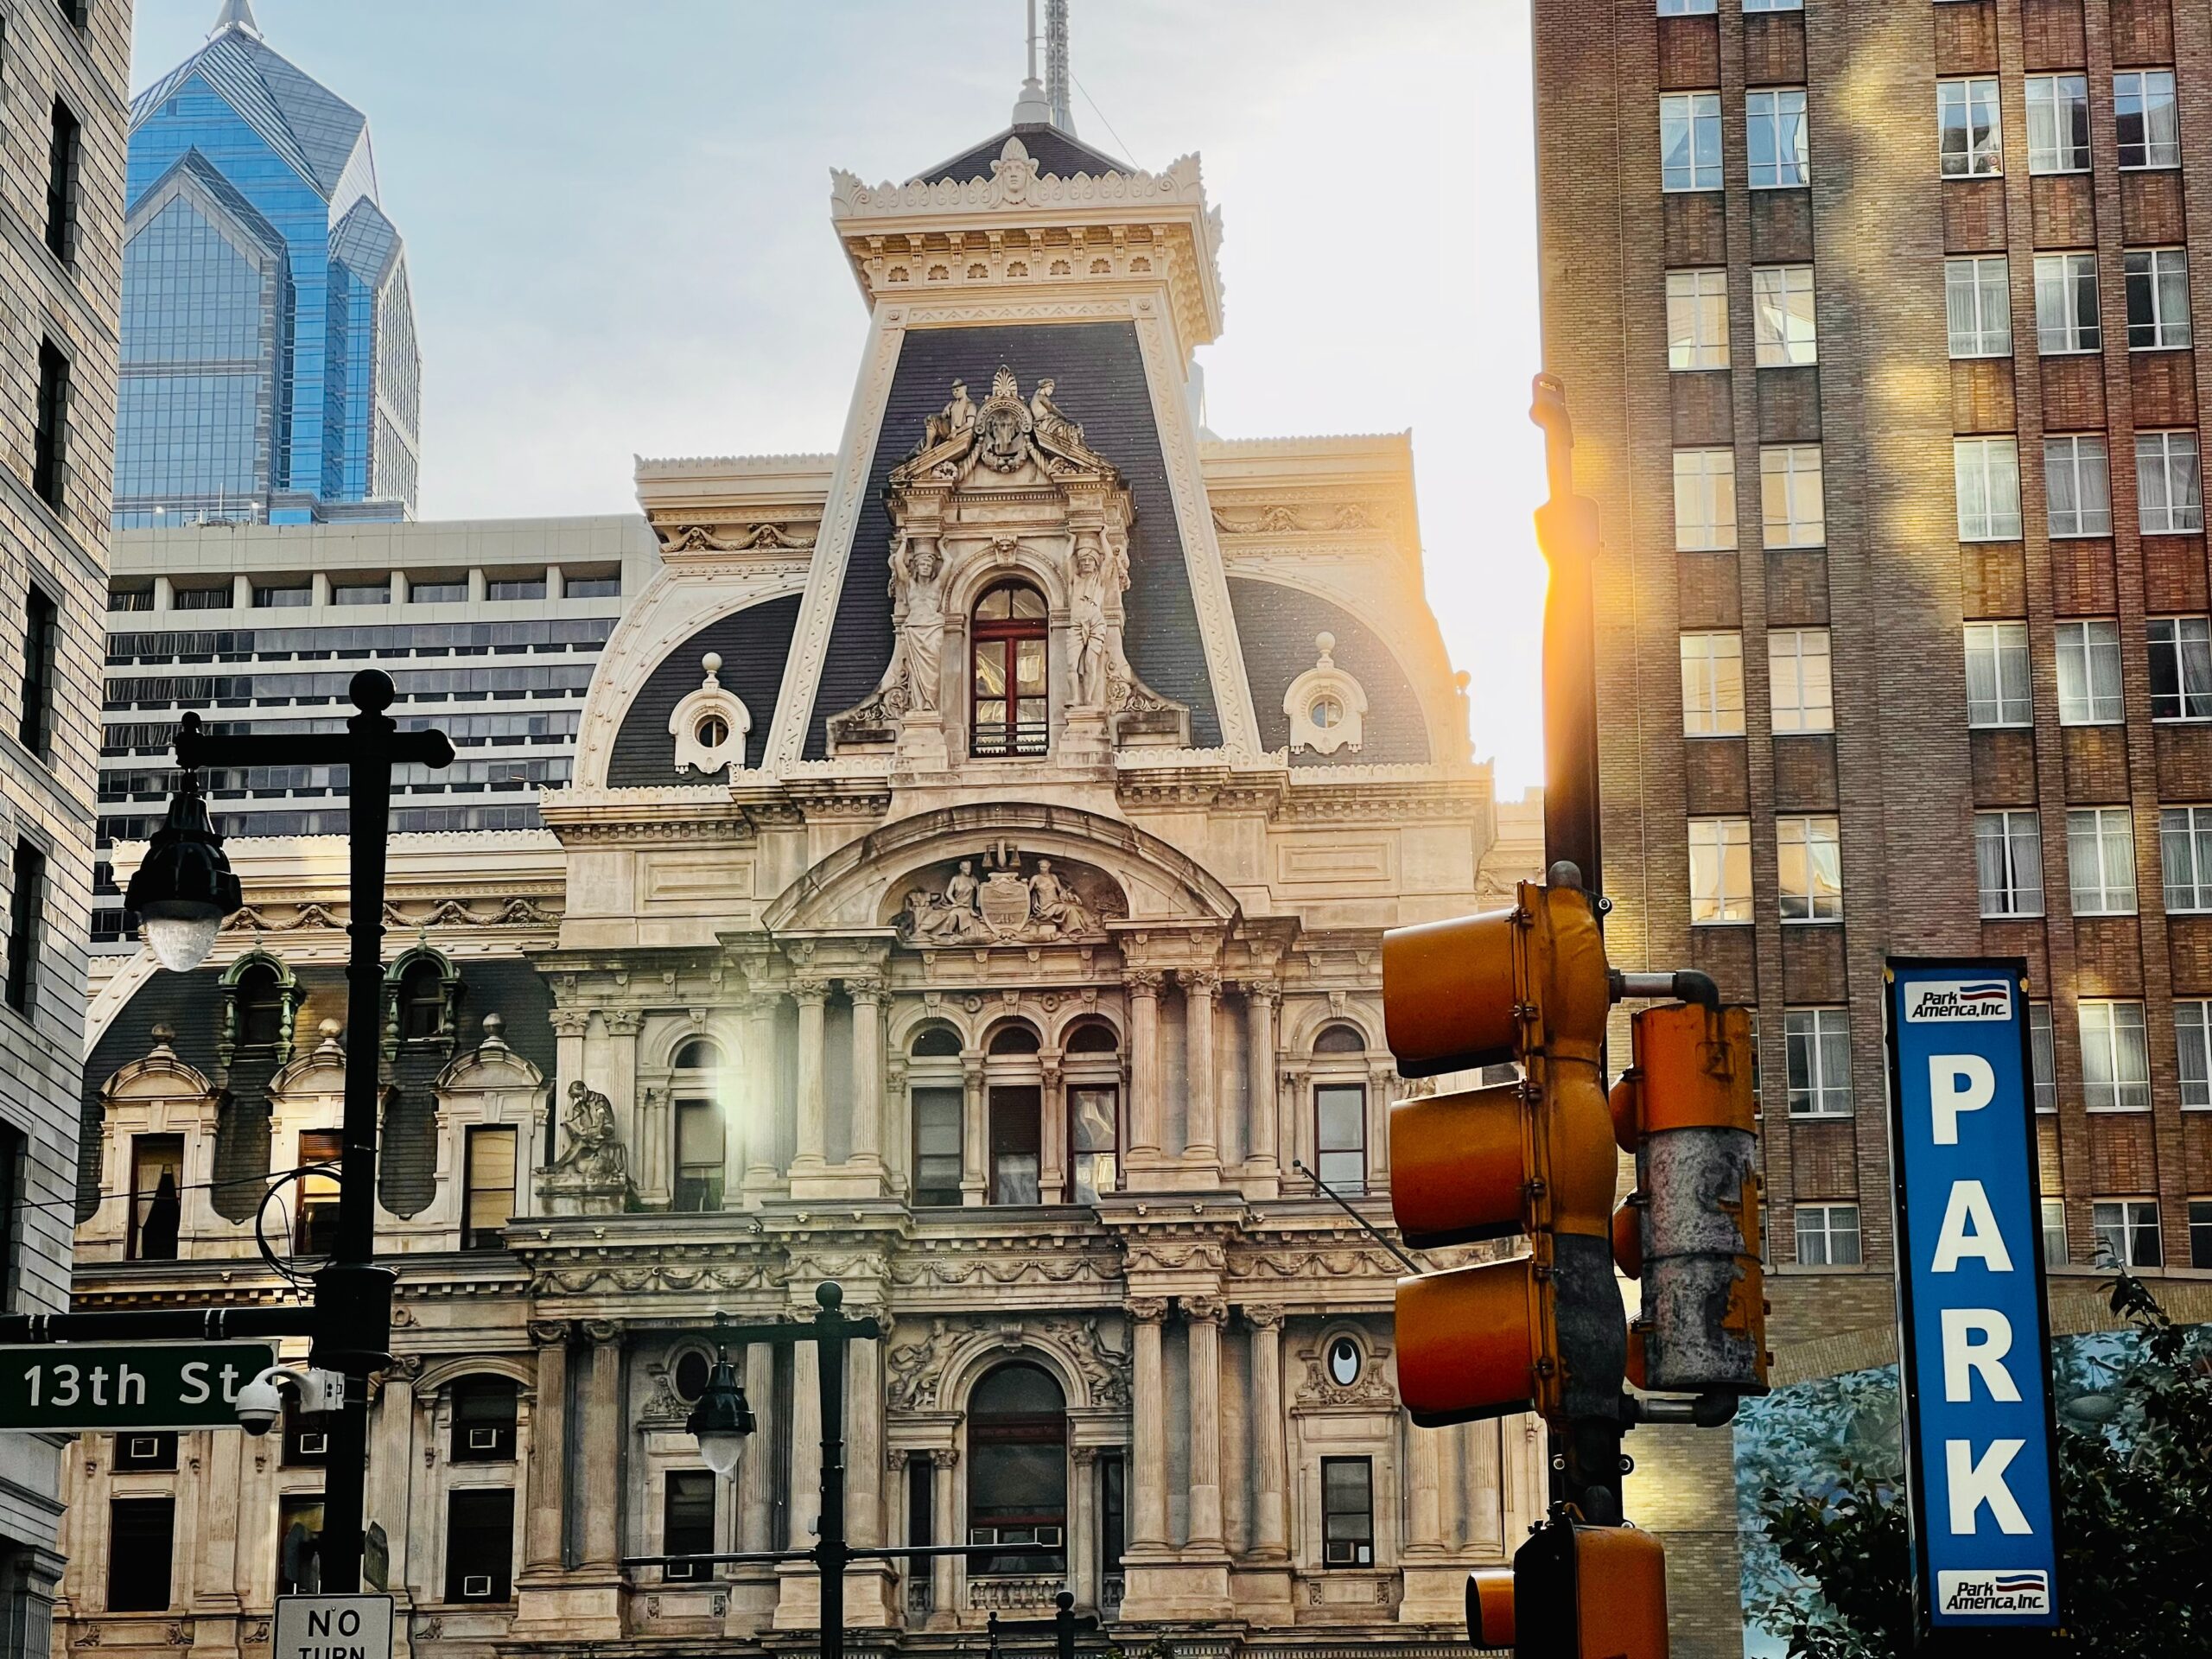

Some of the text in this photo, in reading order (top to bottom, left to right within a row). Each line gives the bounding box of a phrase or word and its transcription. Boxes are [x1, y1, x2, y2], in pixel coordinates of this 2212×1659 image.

[1923, 992, 1957, 1006] Park
[1929, 1054, 2033, 1535] PARK
[24, 1362, 239, 1407] 13th St
[1957, 1582, 1993, 1596] Park
[308, 1610, 360, 1637] NO
